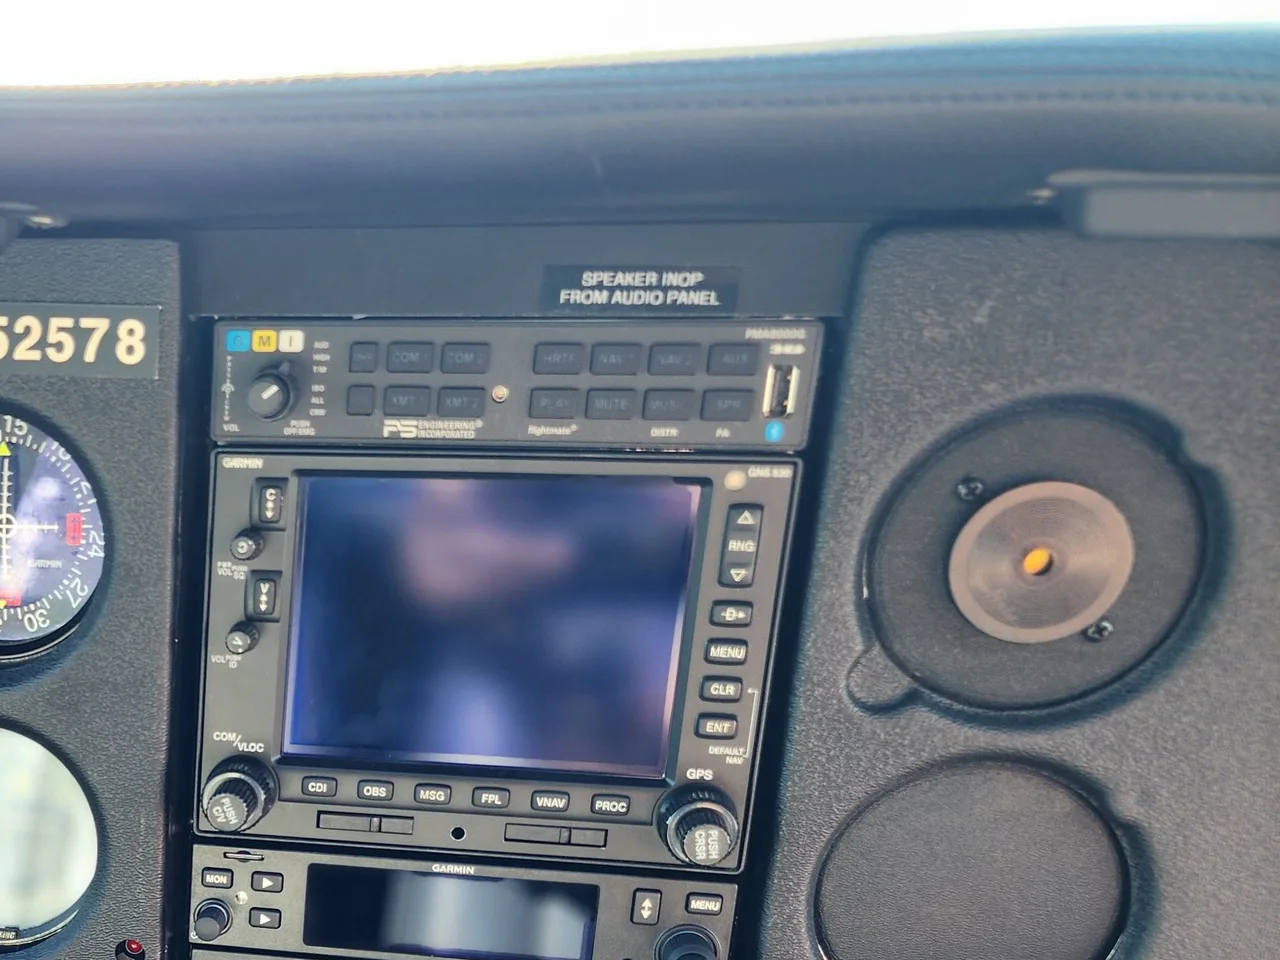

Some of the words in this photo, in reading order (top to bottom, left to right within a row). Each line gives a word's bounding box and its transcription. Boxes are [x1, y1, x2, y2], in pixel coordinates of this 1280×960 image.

[582, 271, 658, 287] SPEAKER
[662, 272, 705, 287] INOP
[560, 290, 608, 305] FROM
[611, 291, 663, 306] AUDIO
[667, 291, 721, 306] PANEL
[418, 420, 475, 430] ENGINEERING
[418, 430, 475, 439] INCORPORATED
[222, 458, 264, 469] GARMIN
[728, 540, 755, 552] RNG
[710, 646, 745, 658] MENU
[710, 684, 735, 695] CLR
[706, 722, 730, 733] ENT
[709, 746, 744, 756] DEFAULT
[686, 769, 713, 780] GPS
[308, 782, 327, 792] CDI
[364, 786, 387, 797] OBS
[420, 790, 444, 801] MSG
[481, 794, 502, 804] FPL
[537, 797, 566, 808] VNAV
[595, 801, 627, 812] PROC
[694, 831, 706, 859] CRSR
[708, 830, 719, 859] PUSH
[432, 864, 474, 874] GARMIN
[206, 875, 227, 884] MON
[691, 900, 720, 911] MENU
